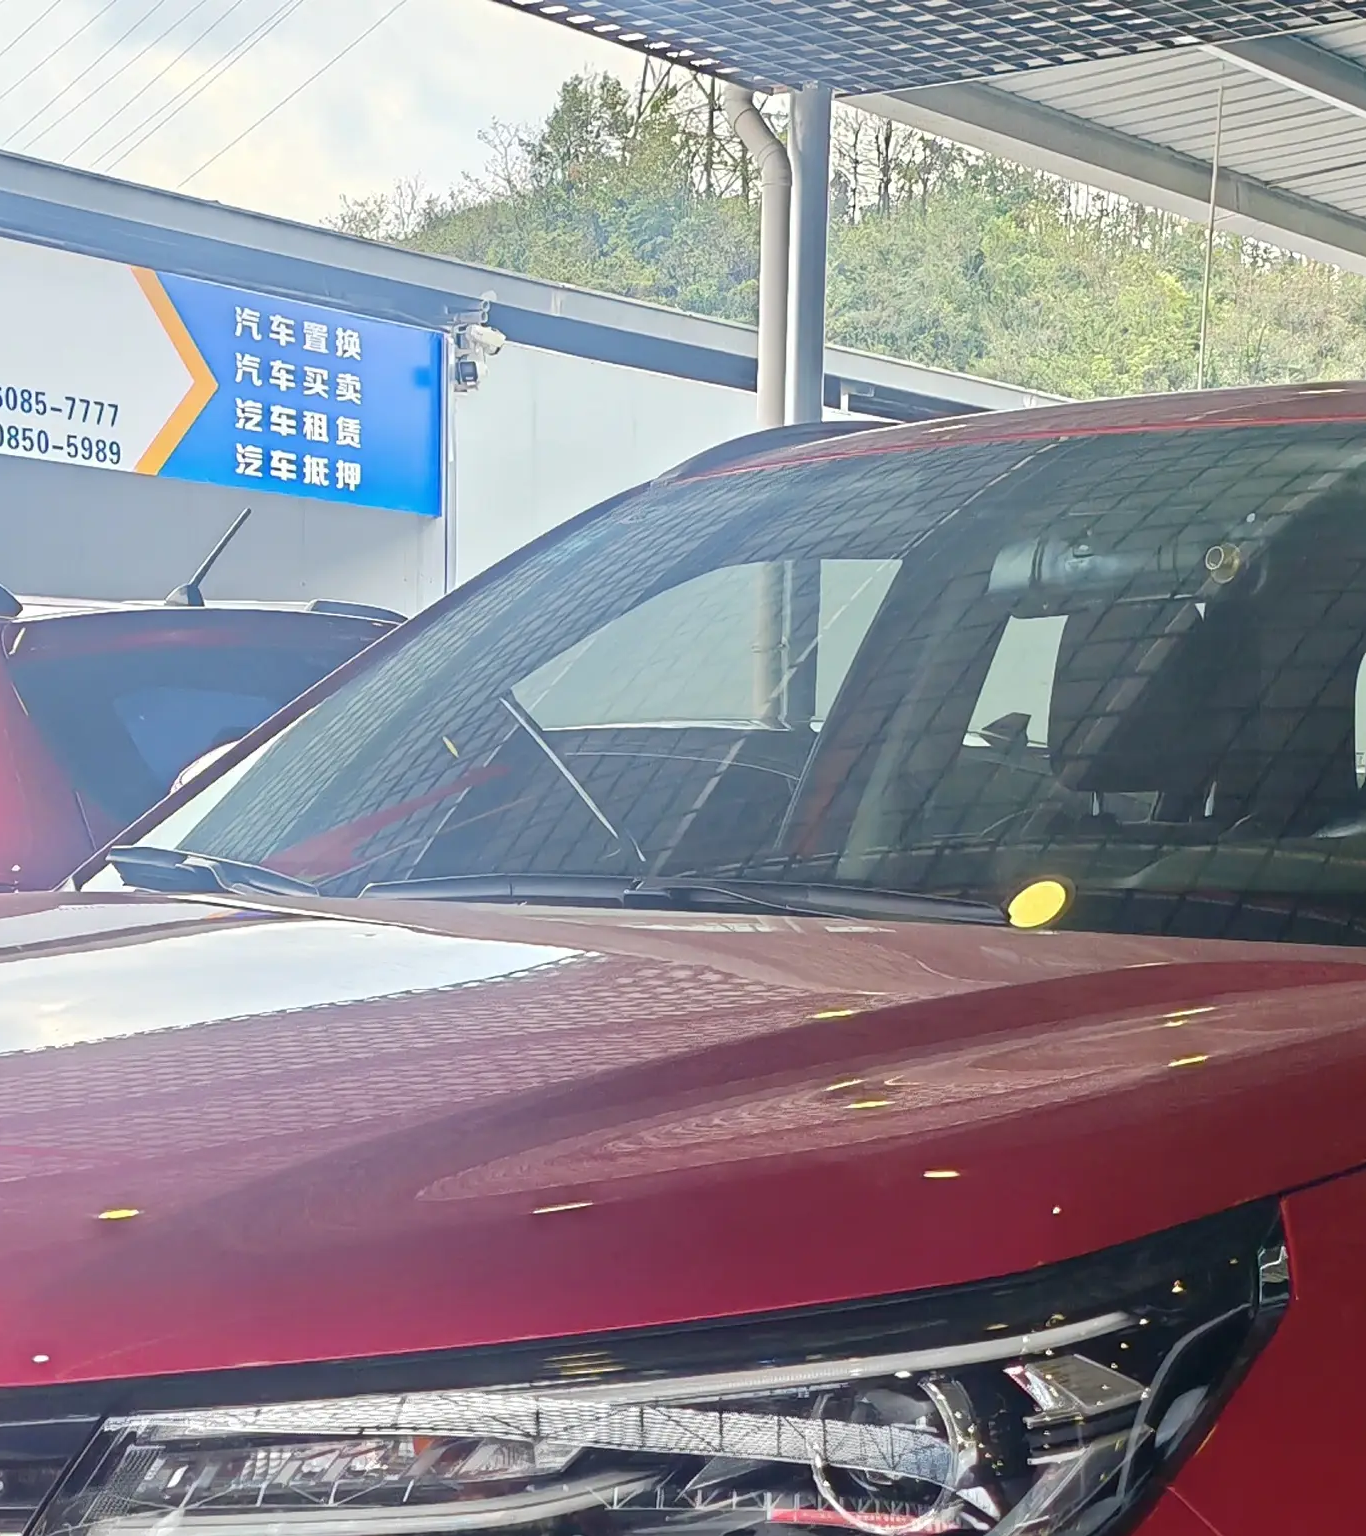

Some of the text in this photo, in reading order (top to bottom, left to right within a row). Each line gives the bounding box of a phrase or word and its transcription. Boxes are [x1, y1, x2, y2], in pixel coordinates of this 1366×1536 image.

[235, 306, 361, 361] 汽车置换
[235, 352, 361, 405] 汽车买卖
[235, 397, 361, 449] 汽车租赁
[235, 442, 361, 491] 汽车抵押
